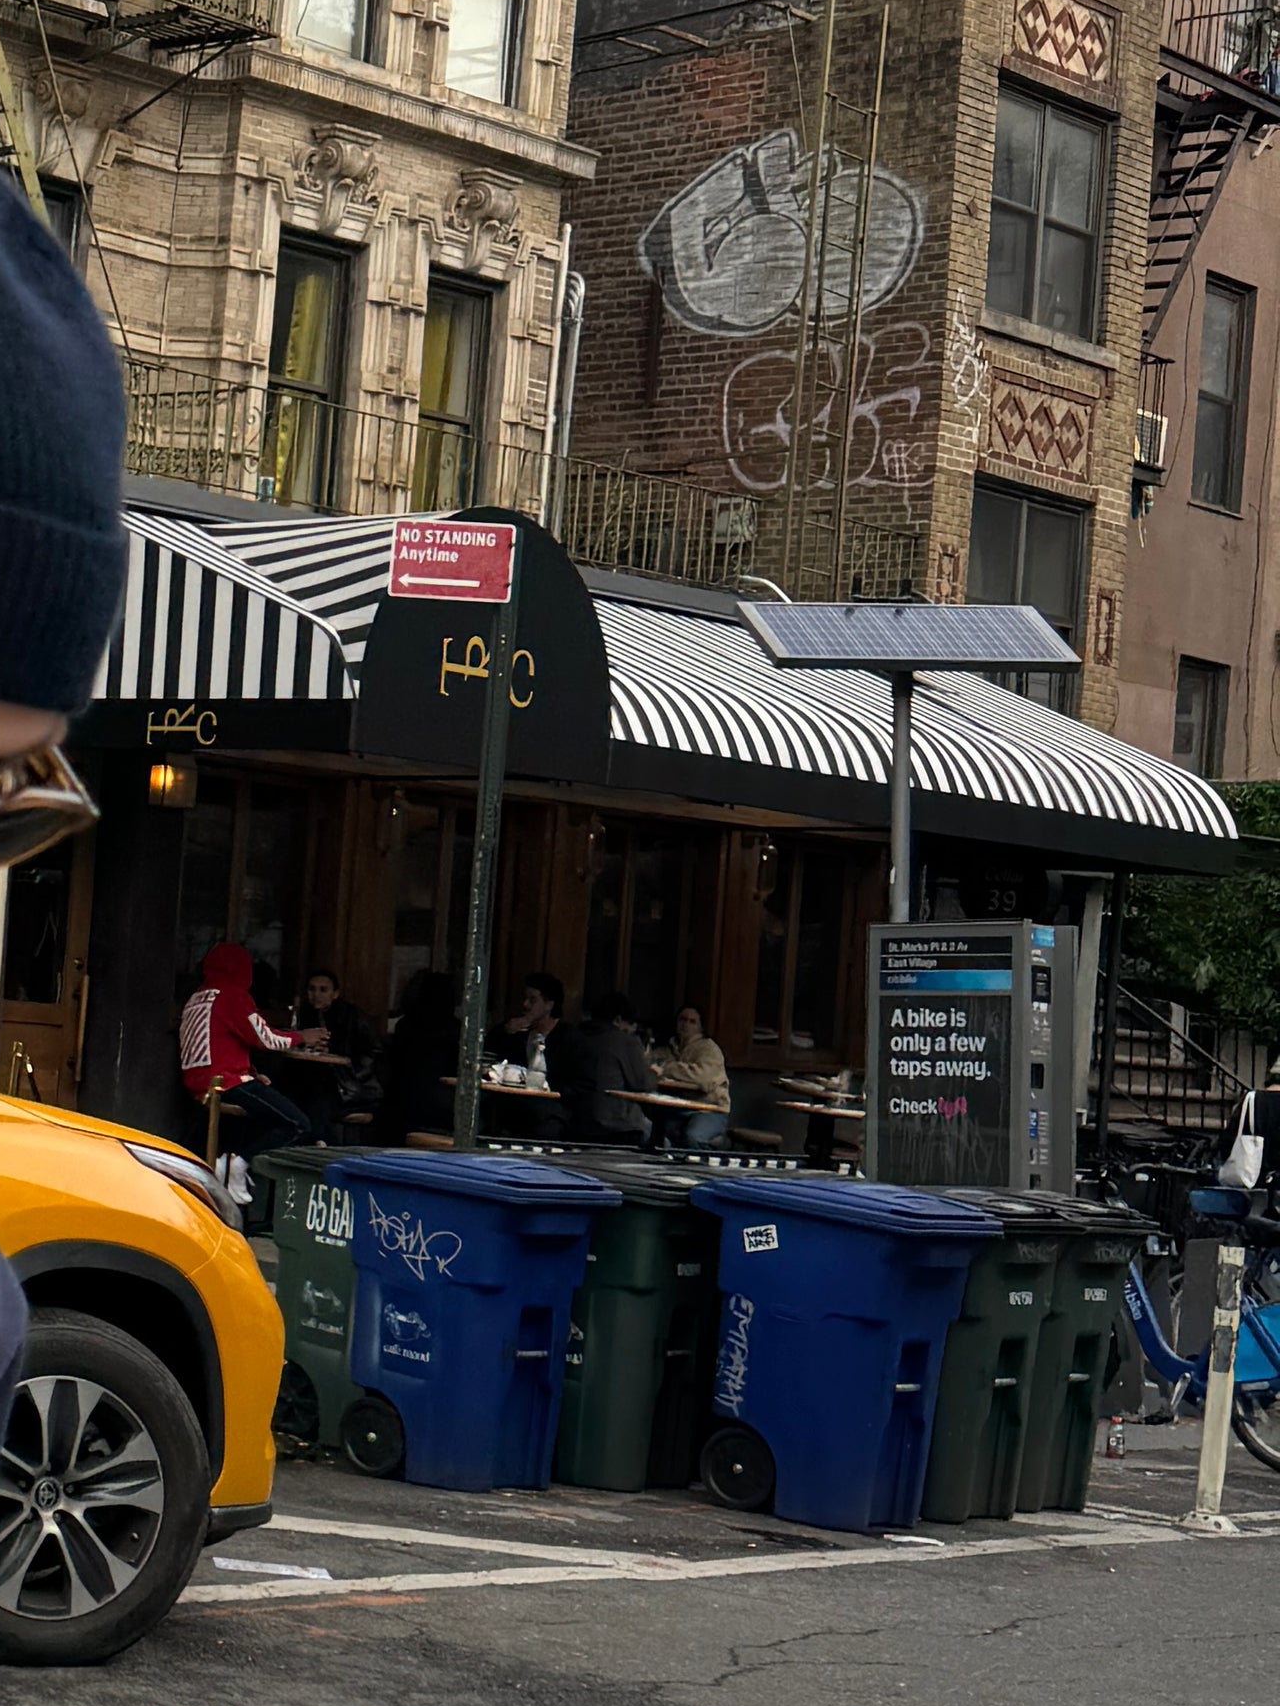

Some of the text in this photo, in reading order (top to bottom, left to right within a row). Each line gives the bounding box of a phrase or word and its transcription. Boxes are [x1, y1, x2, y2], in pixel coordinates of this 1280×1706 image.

[400, 528, 497, 547] NO STANDING
[399, 546, 459, 564] Anytime
[987, 889, 1017, 912] 39
[891, 1007, 967, 1028] A bike is
[890, 1033, 986, 1055] only a few
[891, 1058, 991, 1080] taps away.
[890, 1097, 938, 1115] Check
[306, 1184, 328, 1233] 65
